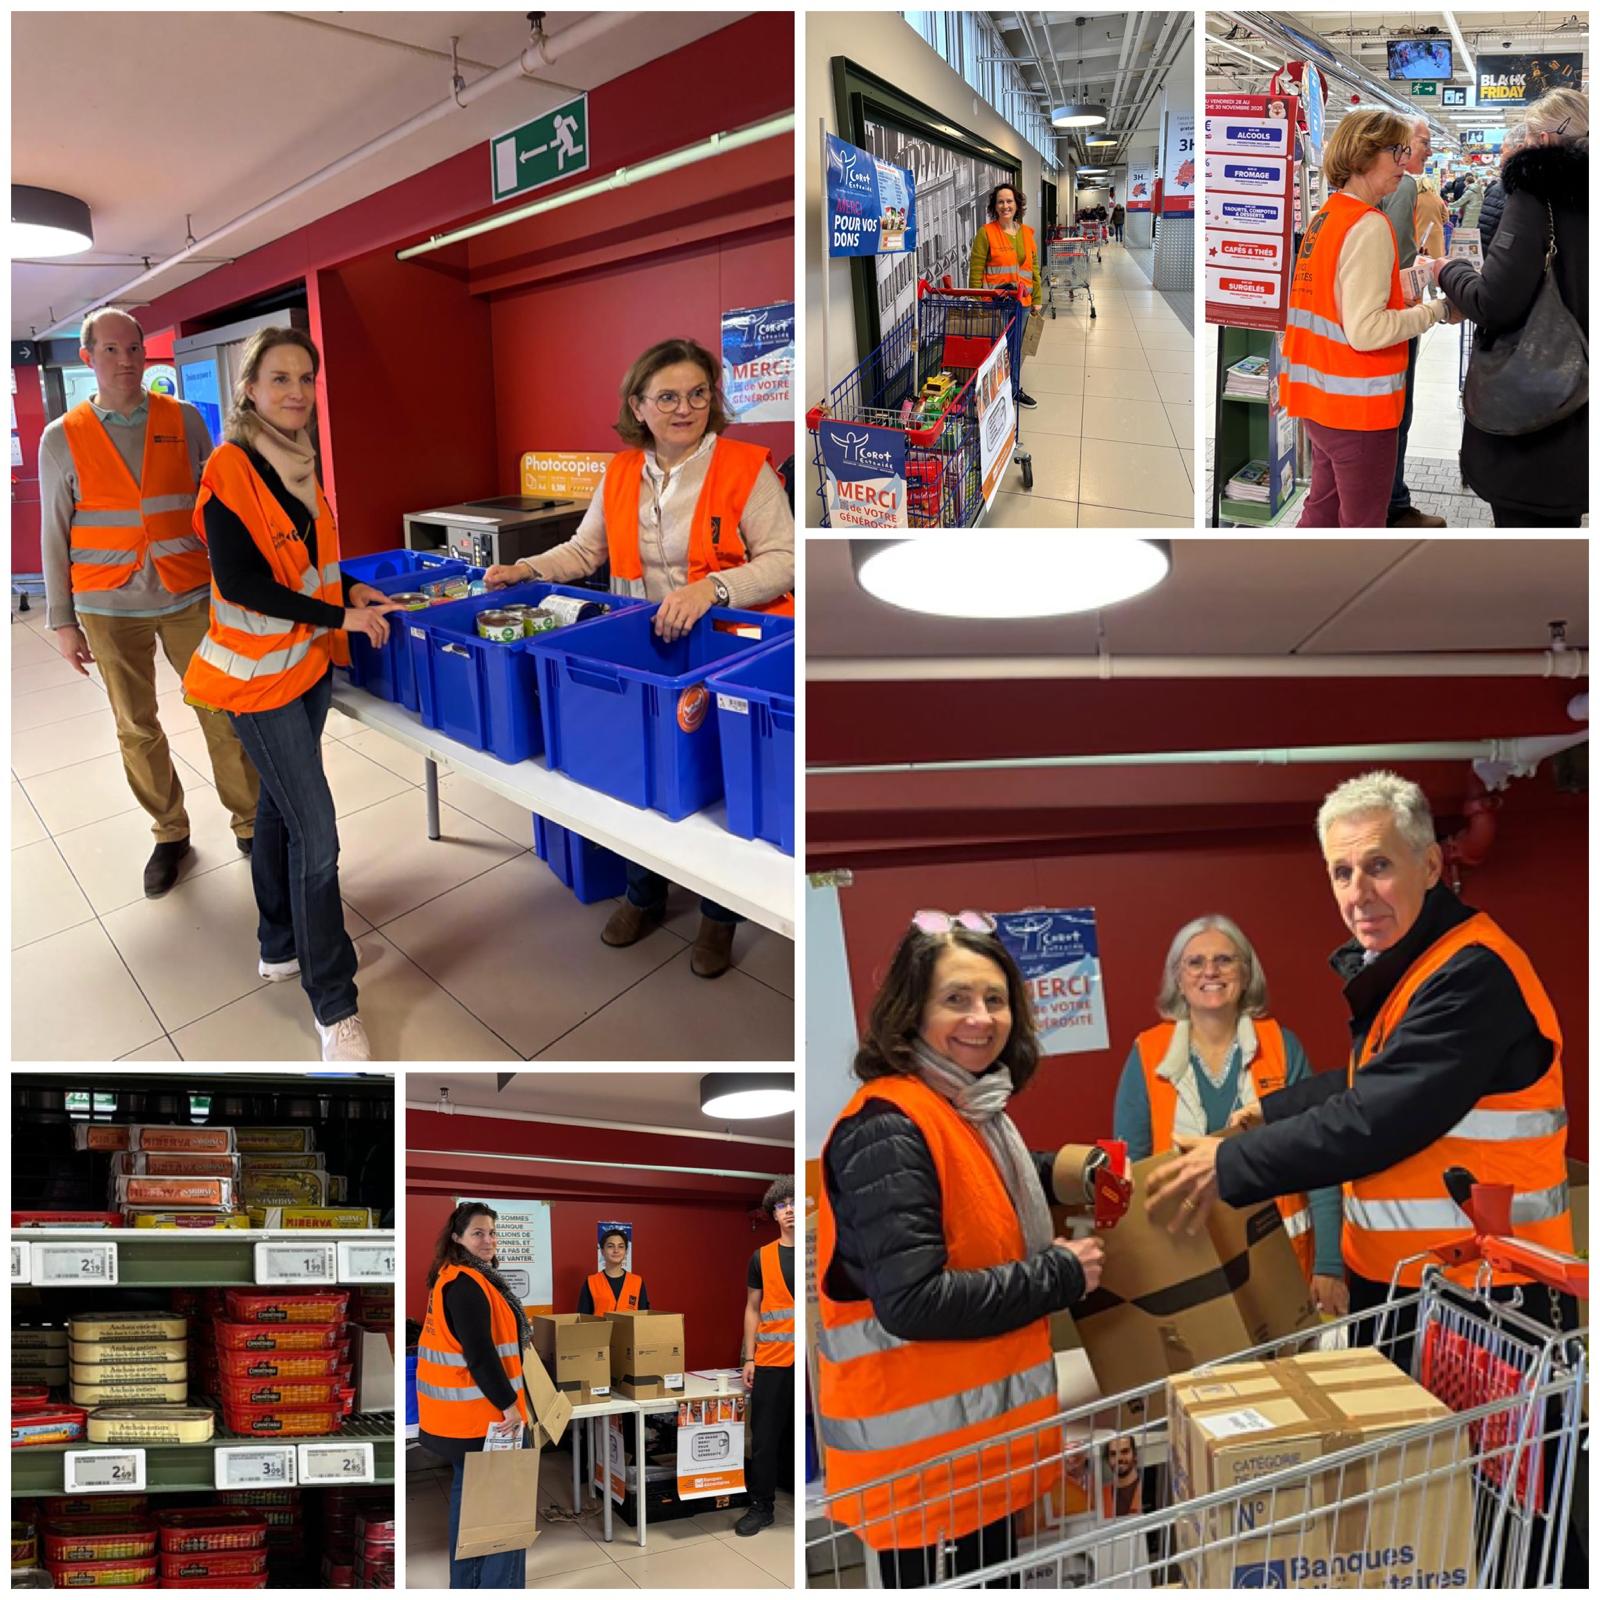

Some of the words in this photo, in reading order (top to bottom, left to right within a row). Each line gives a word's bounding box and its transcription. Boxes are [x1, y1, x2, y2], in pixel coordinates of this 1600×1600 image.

[1480, 86, 1526, 98] FRIDAY
[1237, 132, 1270, 140] ALCOOLS
[1234, 171, 1270, 179] FROMAGE
[834, 215, 860, 231] POUR
[861, 219, 878, 232] VOS
[834, 232, 860, 247] DONS
[1224, 245, 1246, 254] CAFÉS
[1254, 247, 1274, 256] THÉS
[1228, 282, 1265, 293] SURGELÉS
[733, 361, 790, 380] MERCI
[757, 381, 790, 390] VOTRE
[733, 391, 790, 404] GÉNÉROSITÉ
[525, 454, 607, 476] Photocopies
[837, 480, 897, 509] MERCI
[849, 504, 862, 513] de
[863, 507, 897, 523] VOTRE
[1050, 1000, 1091, 1011] VOTRE
[286, 1218, 332, 1228] MINERVA
[1290, 1544, 1414, 1581] Banques
